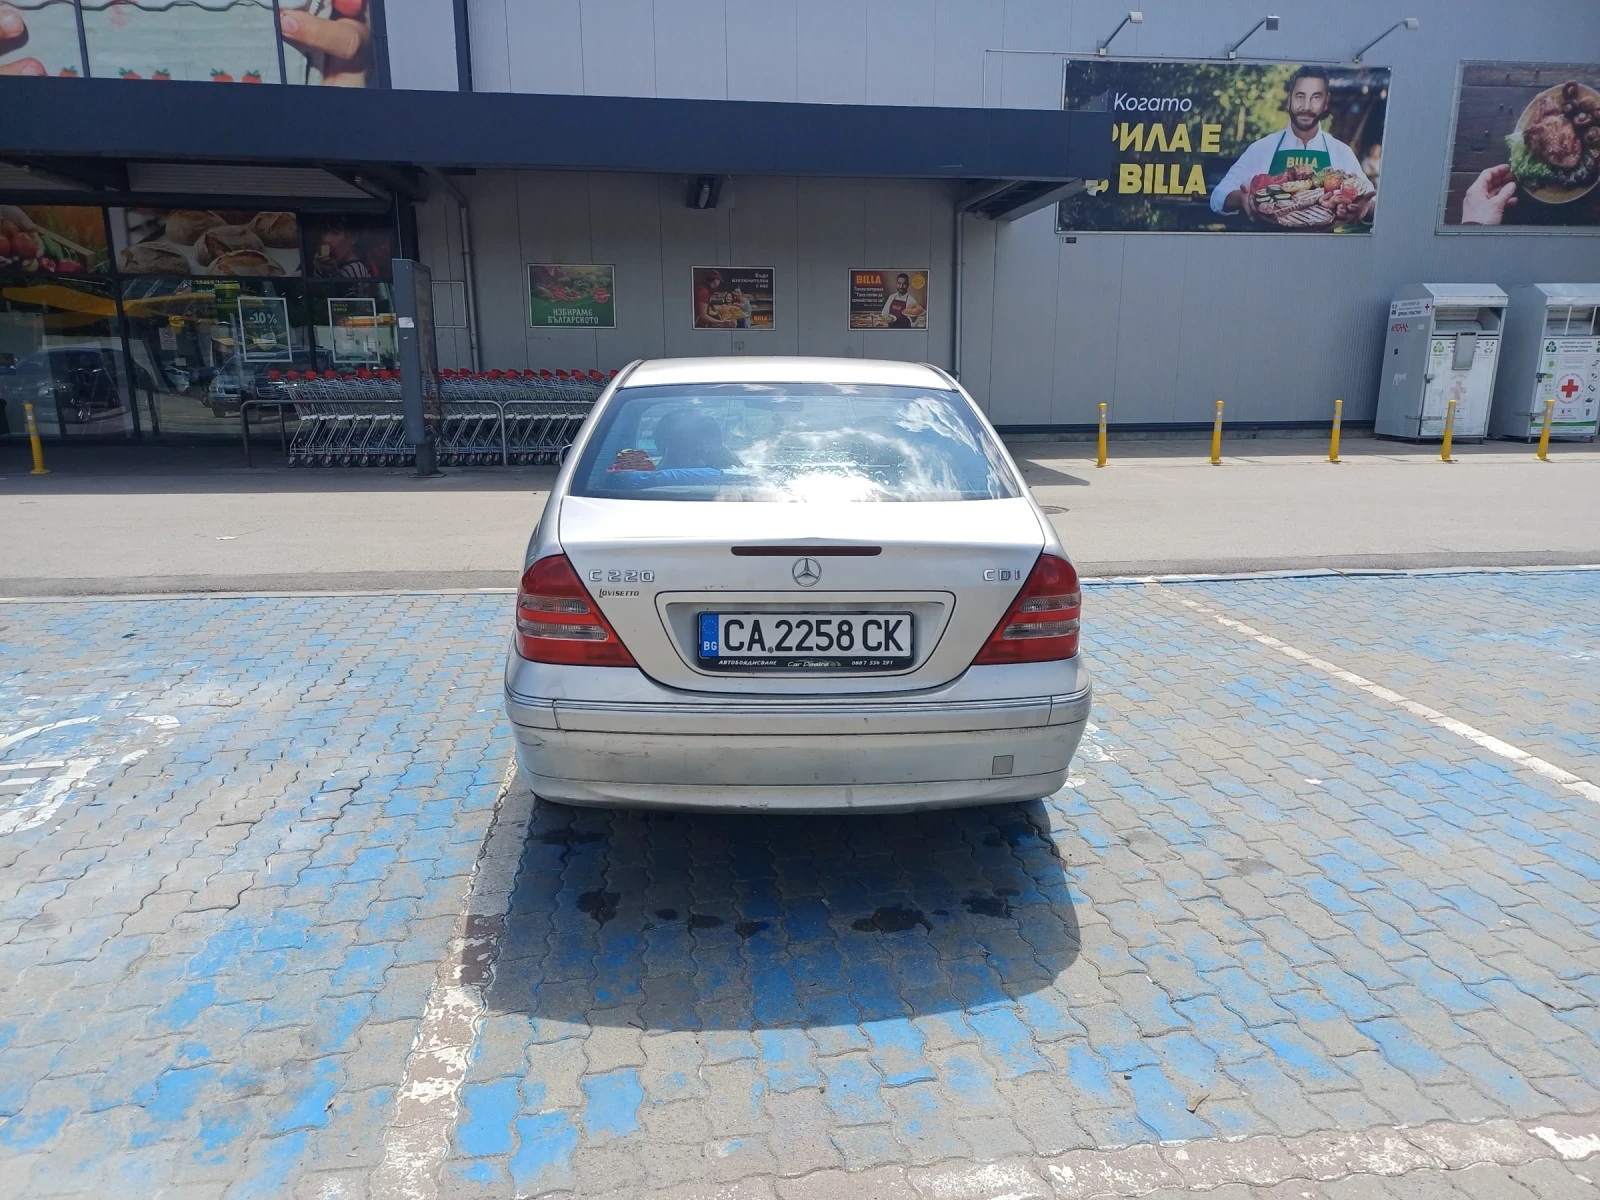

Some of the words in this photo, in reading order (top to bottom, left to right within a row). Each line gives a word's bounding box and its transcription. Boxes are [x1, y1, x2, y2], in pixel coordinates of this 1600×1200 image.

[1114, 92, 1192, 112] Когато
[1118, 163, 1207, 195] BILLA
[856, 275, 882, 284] BILLA
[552, 308, 593, 316] ИЗБИРАМЕ
[547, 316, 599, 324] БЪЛГАРСКОТО
[588, 568, 602, 582] C
[607, 569, 655, 583] 220
[983, 568, 1020, 582] CDI
[724, 619, 766, 652] CA
[774, 619, 854, 652] 2258
[862, 619, 904, 652] CK
[703, 641, 717, 651] BG
